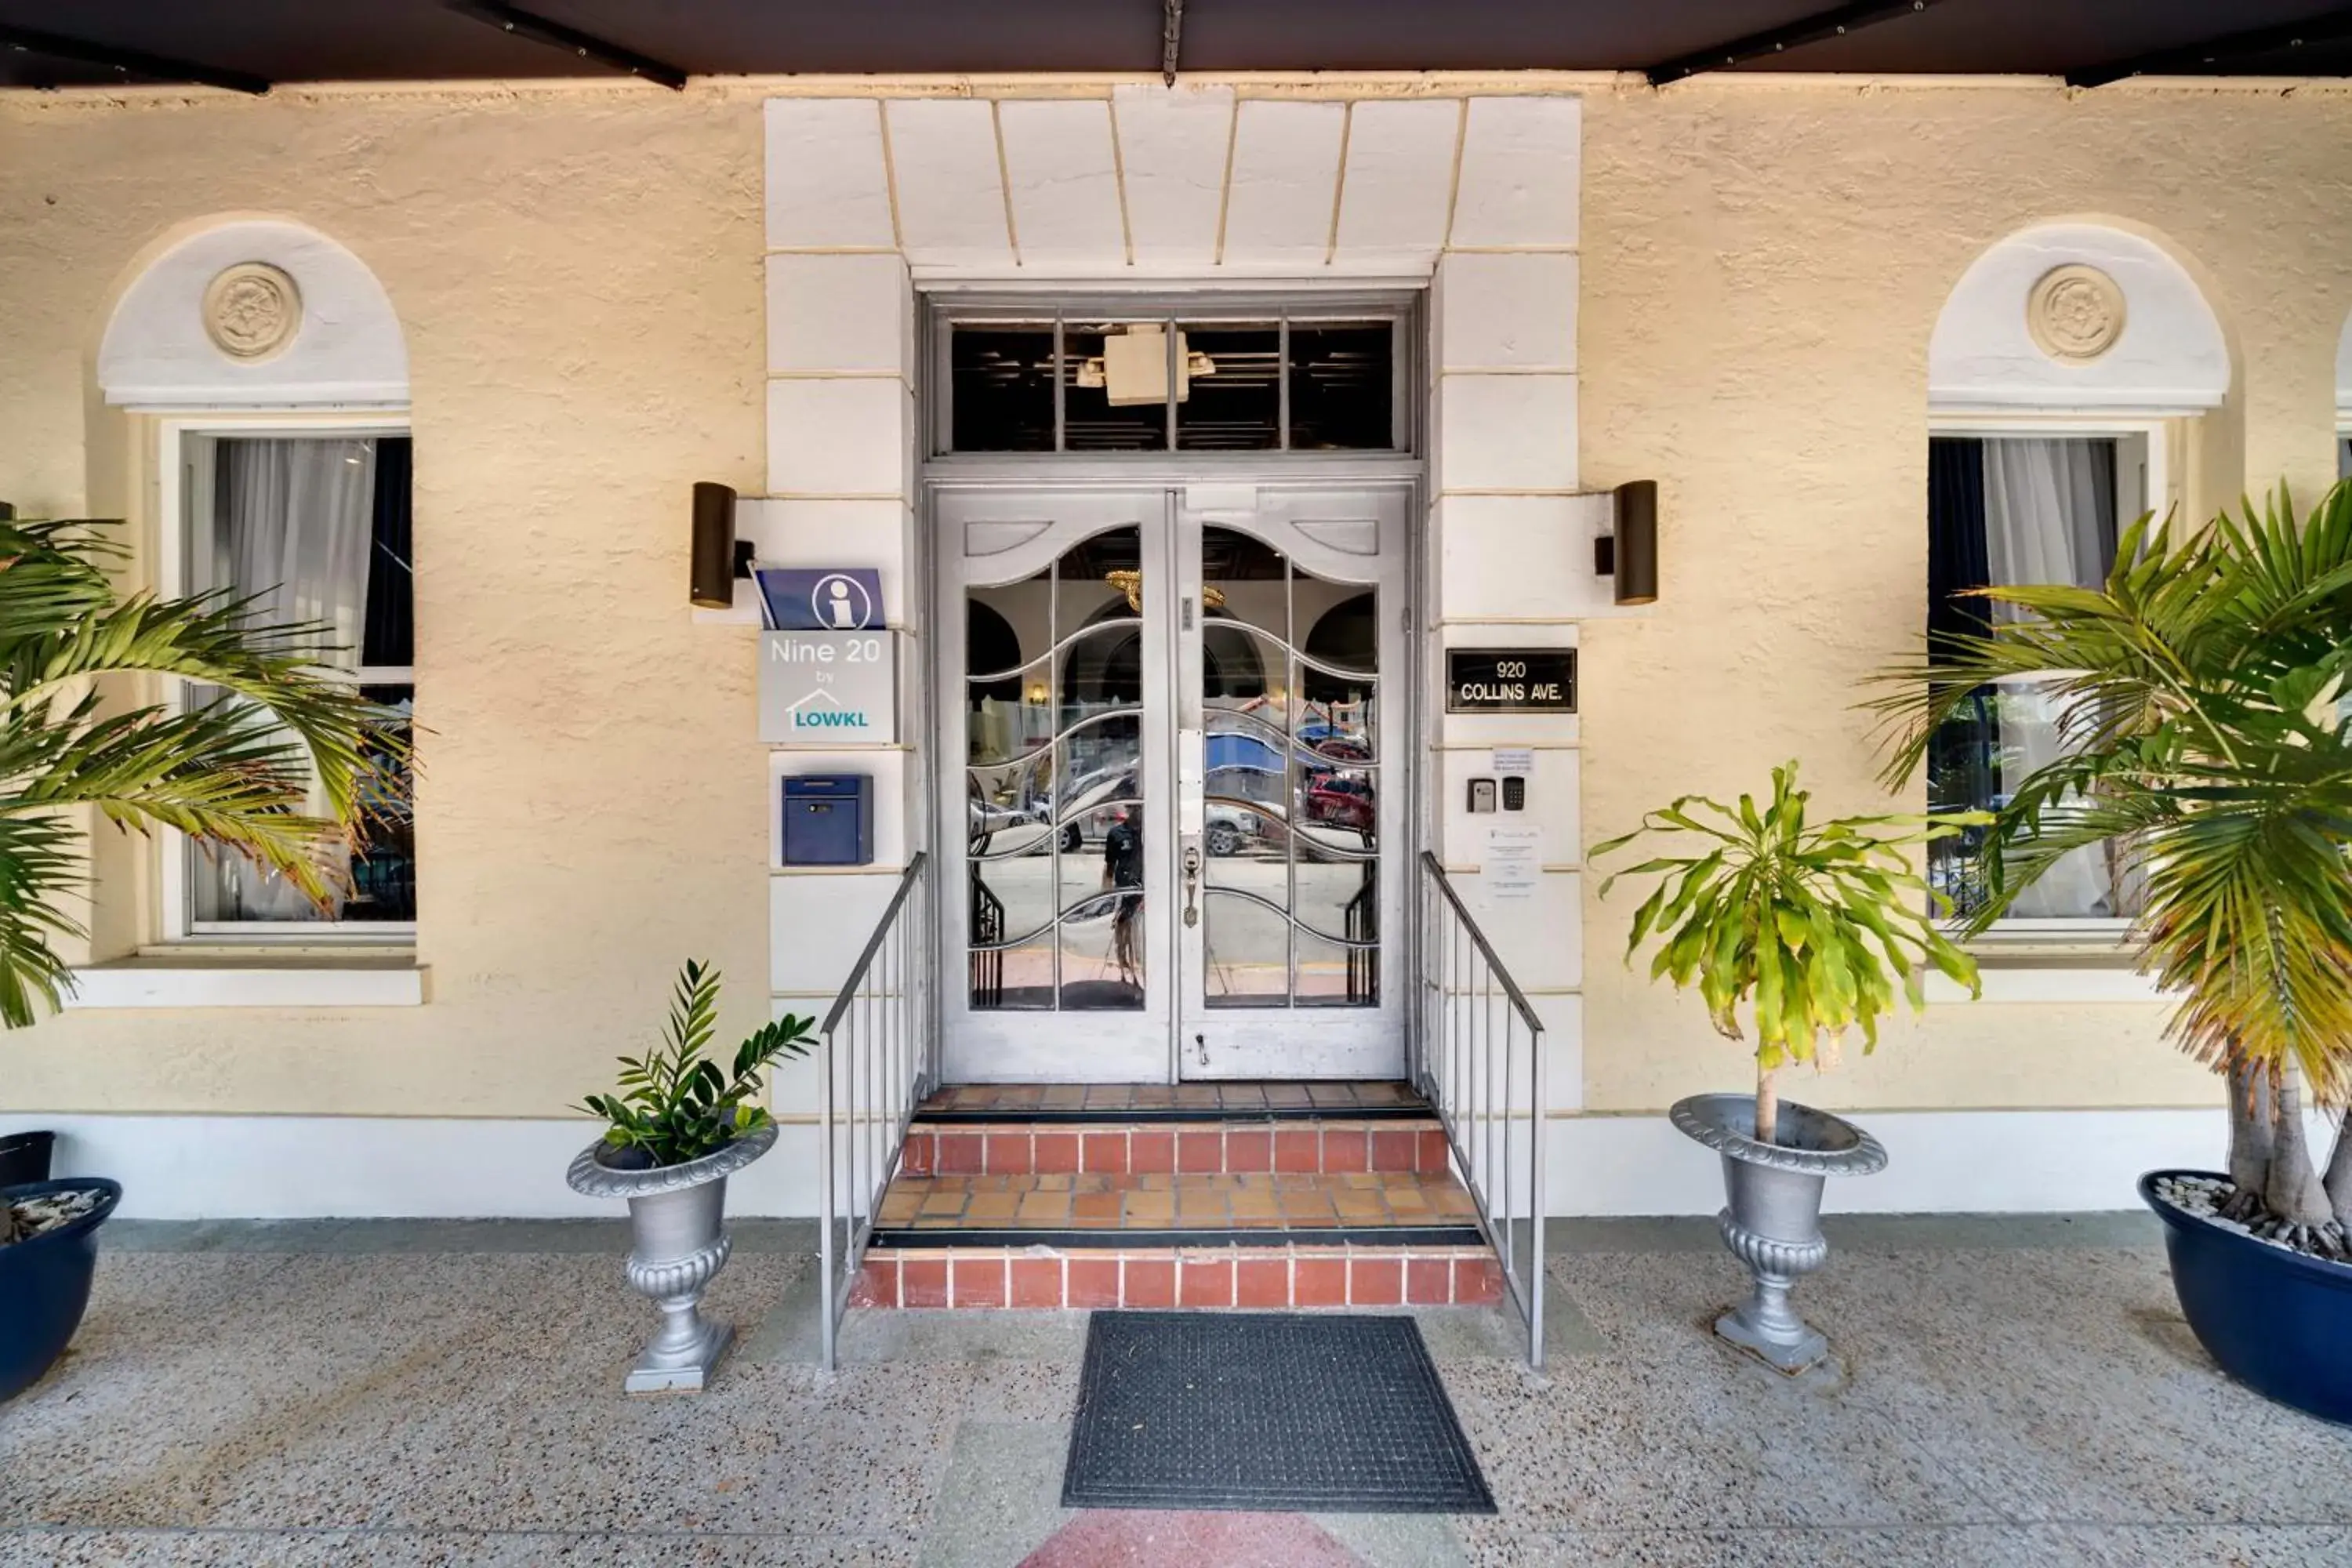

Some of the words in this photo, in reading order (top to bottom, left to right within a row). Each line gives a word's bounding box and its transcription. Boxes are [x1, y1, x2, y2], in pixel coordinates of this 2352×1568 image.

[771, 638, 836, 663] Nine
[846, 638, 880, 662] 20
[815, 670, 834, 684] by
[1496, 661, 1526, 678] 920
[1461, 683, 1525, 700] COLLINS
[1530, 683, 1563, 700] AVE.
[795, 712, 869, 727] LOWKL
